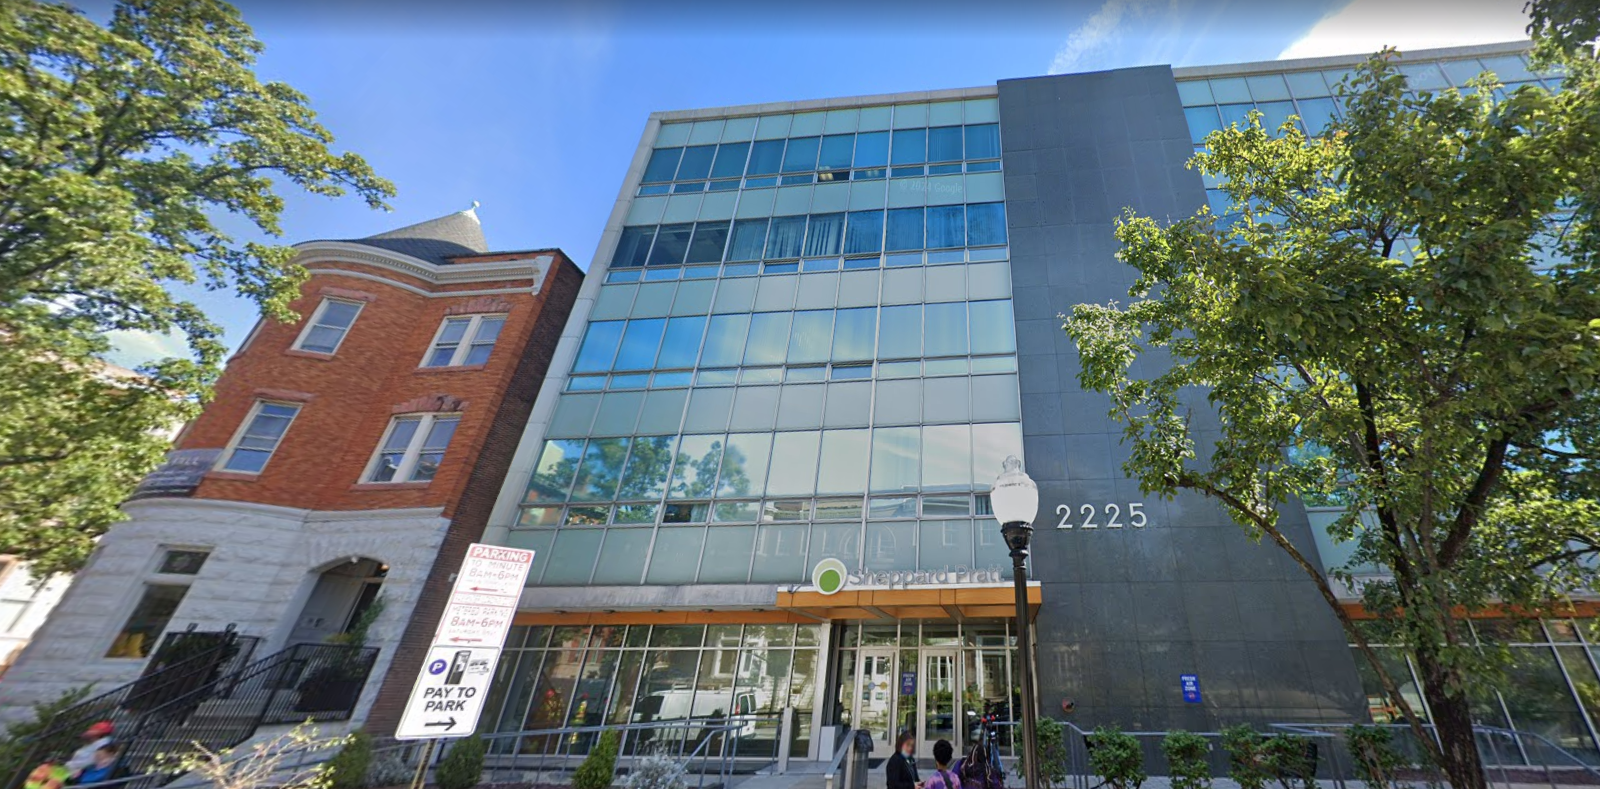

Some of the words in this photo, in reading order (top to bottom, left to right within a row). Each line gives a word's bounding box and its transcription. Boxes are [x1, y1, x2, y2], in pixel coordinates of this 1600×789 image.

[1056, 503, 1147, 528] 2225
[472, 547, 528, 562] PARKING
[487, 561, 524, 572] MINUTE
[850, 565, 949, 589] Sheppard
[955, 564, 1004, 583] Pratt
[450, 616, 504, 628] 8AM-6PM
[423, 687, 454, 698] PAY
[457, 687, 476, 698] TO
[424, 700, 467, 712] PARK
